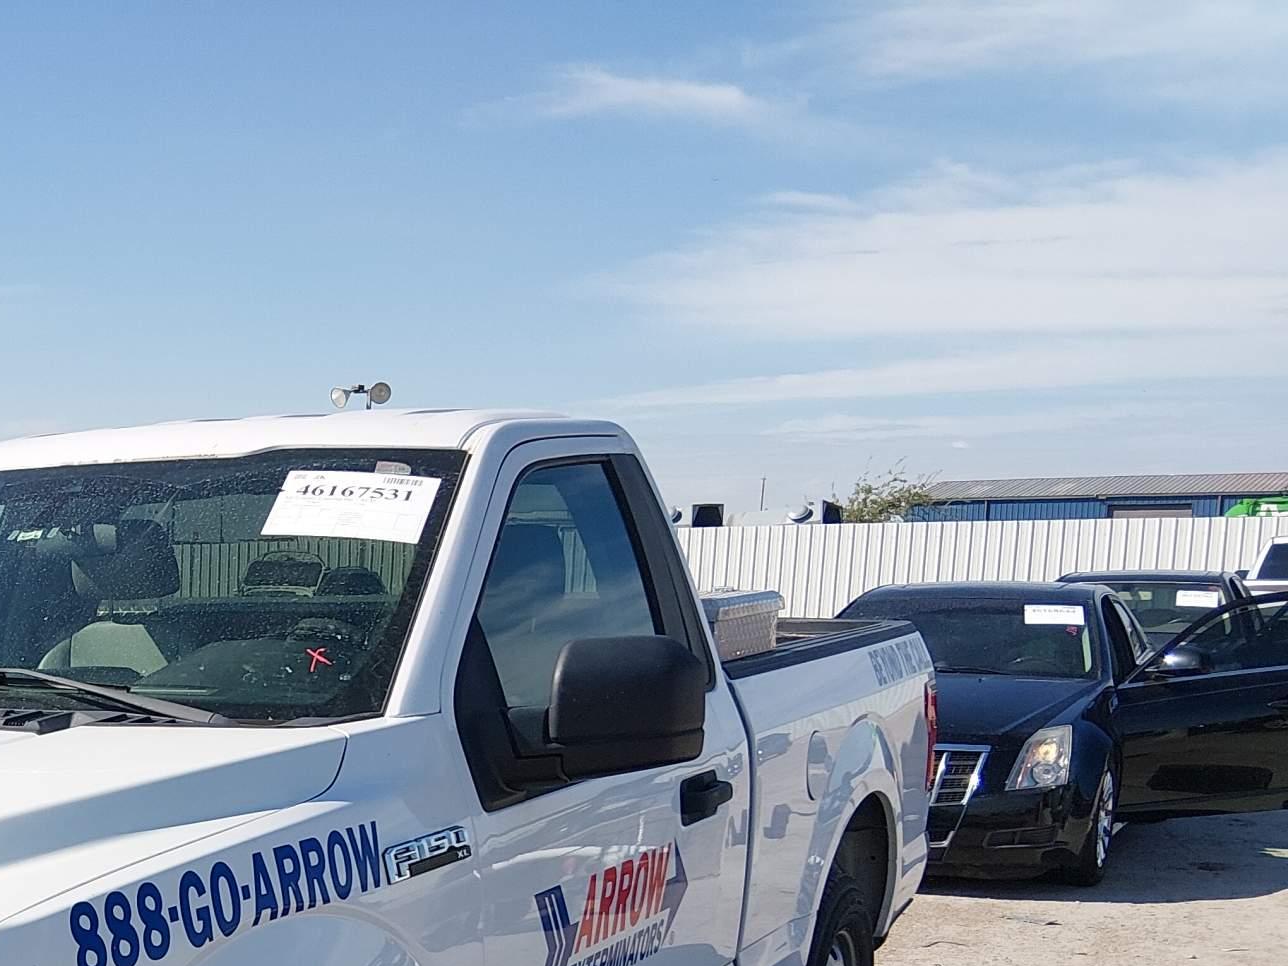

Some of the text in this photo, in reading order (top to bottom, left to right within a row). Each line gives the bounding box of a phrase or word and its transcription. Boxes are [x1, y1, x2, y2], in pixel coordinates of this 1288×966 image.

[296, 484, 413, 502] 46167531
[457, 849, 469, 859] XL
[575, 842, 673, 955] ARROW
